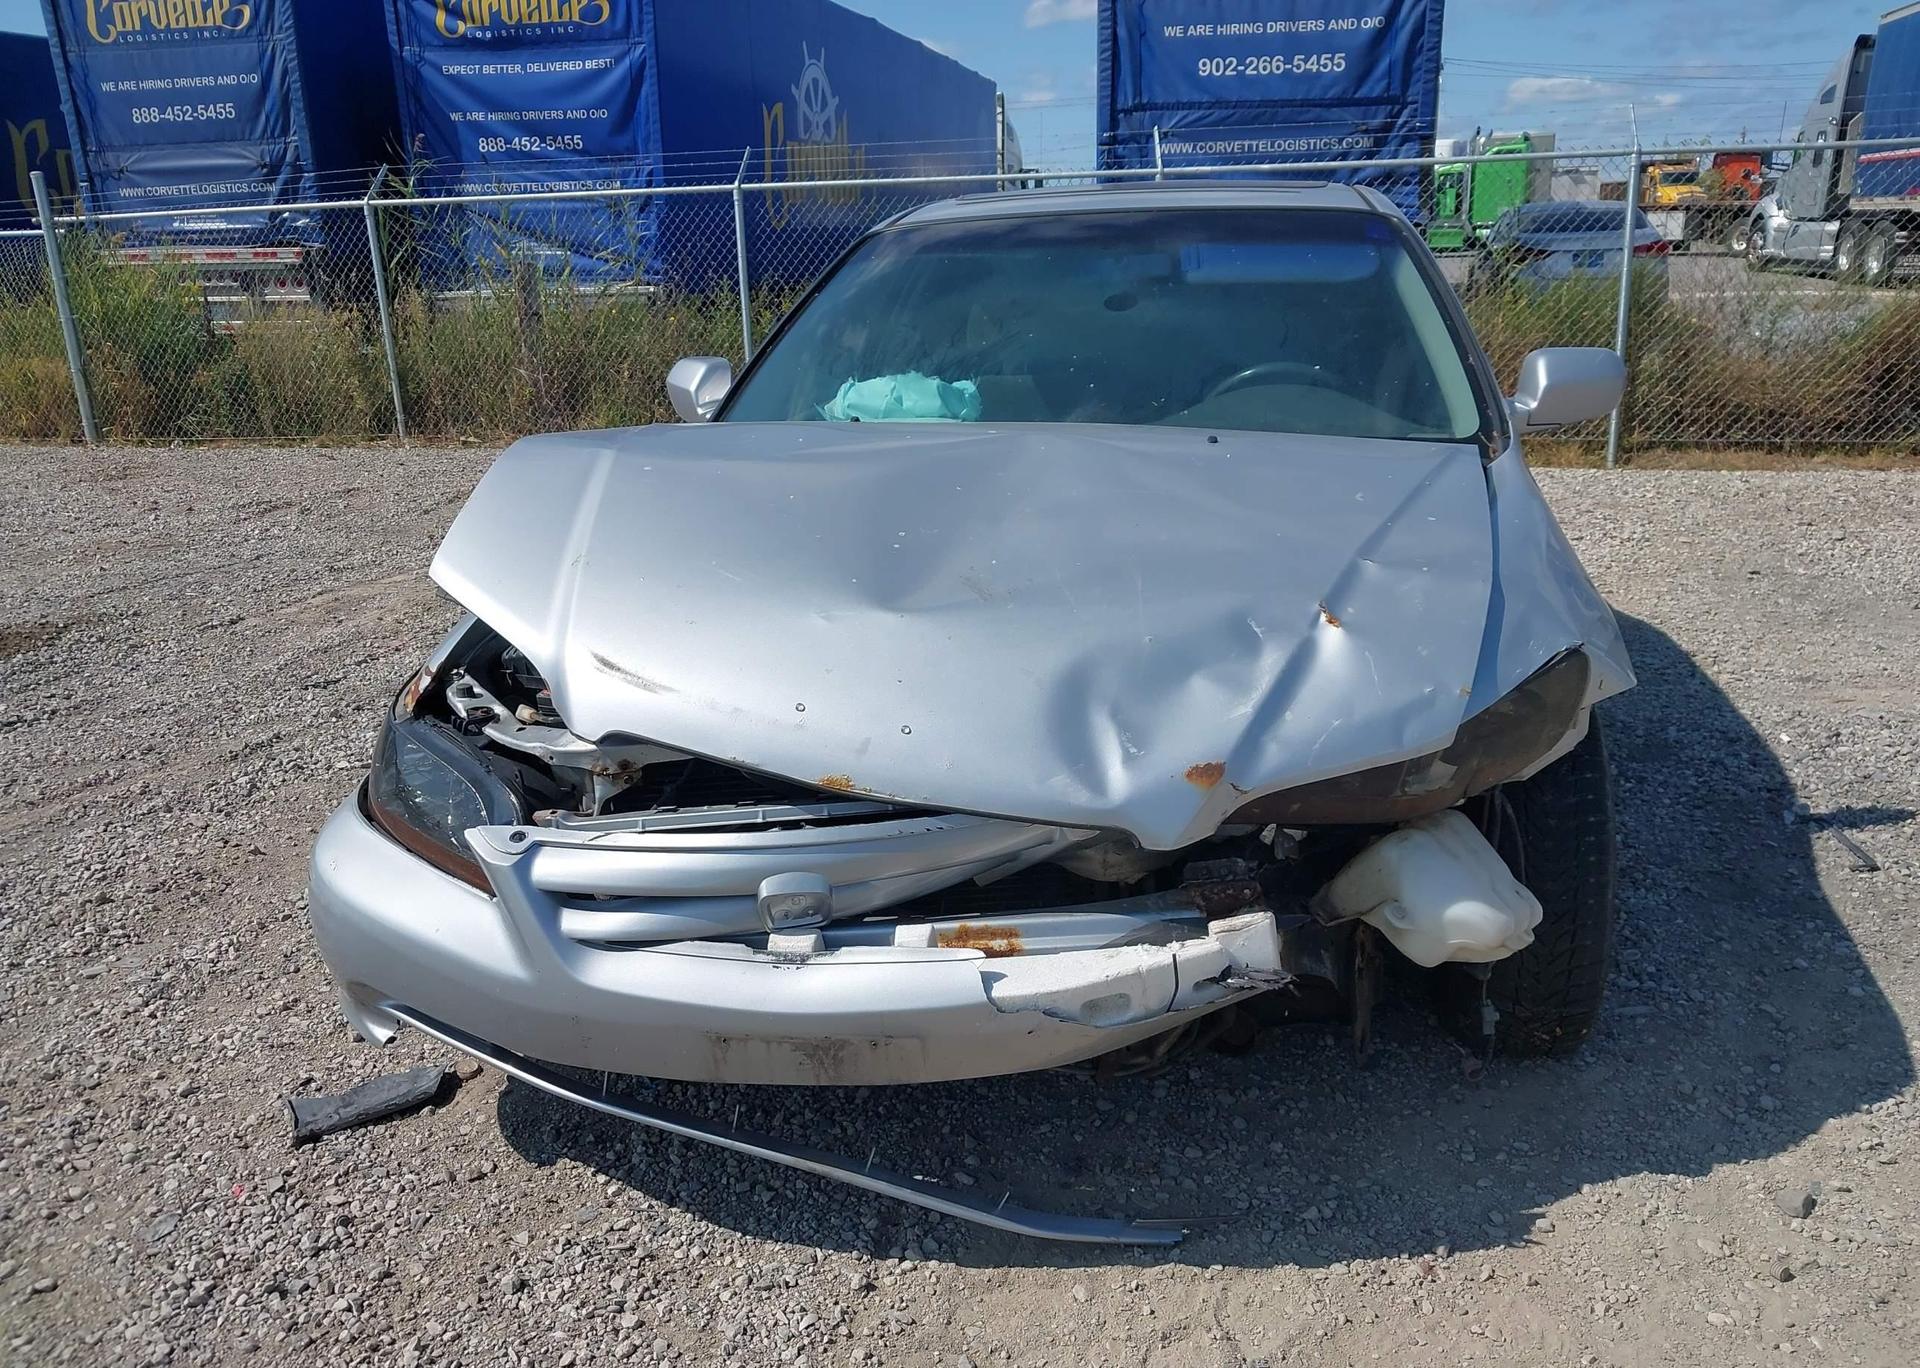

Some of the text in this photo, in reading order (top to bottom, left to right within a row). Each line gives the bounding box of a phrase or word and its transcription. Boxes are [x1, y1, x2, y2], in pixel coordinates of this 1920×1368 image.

[467, 25, 582, 38] LOGISTICS INC.
[1164, 16, 1385, 37] WE ARE HIRING DRIVERS AND O/O
[119, 29, 226, 43] LOGISTICS INC.
[442, 58, 615, 75] EXPECT BETTER, DELIVERED BEST!
[1198, 53, 1346, 76] 902-266-5455
[101, 82, 117, 92] WE
[118, 81, 137, 91] ARE
[139, 79, 172, 90] HIRING
[174, 76, 215, 88] DRIVERS
[217, 74, 238, 85] AND
[132, 103, 236, 124] 888-452-5455
[450, 112, 465, 121] WE
[466, 111, 486, 121] ARE
[488, 111, 521, 121] HIRING
[522, 110, 564, 120] DRIVERS
[566, 109, 587, 119] AND
[478, 135, 583, 152] 888-452-5455
[1161, 136, 1374, 155] WWW.CORVETTELOGISTICS.COM
[119, 182, 276, 197] WWW.CORVETTELOGISTICS.COM
